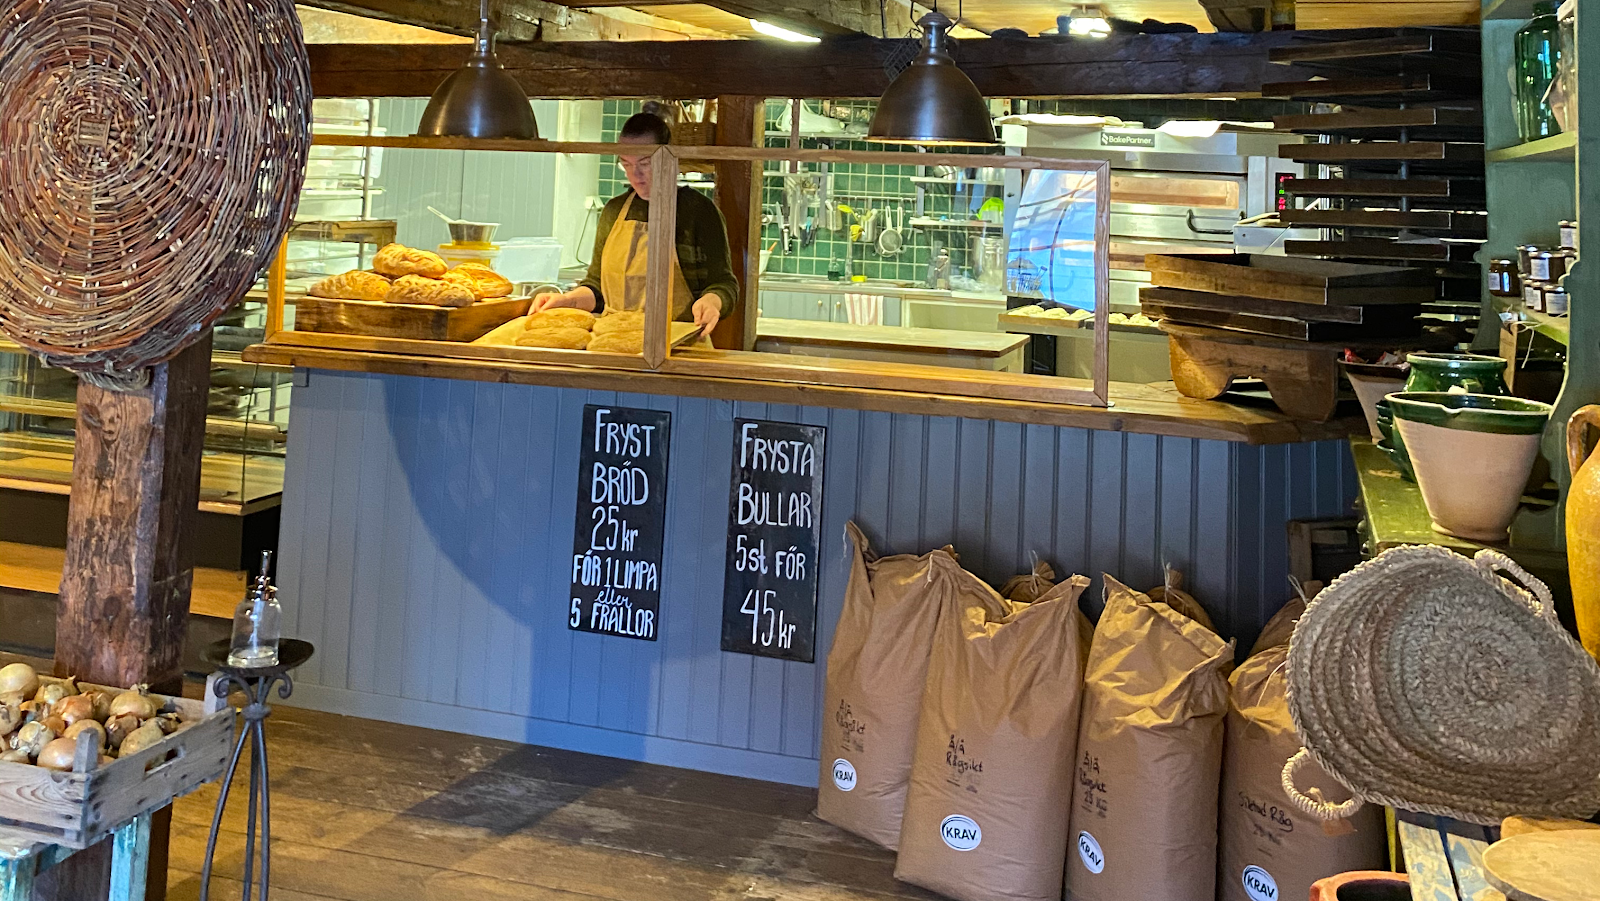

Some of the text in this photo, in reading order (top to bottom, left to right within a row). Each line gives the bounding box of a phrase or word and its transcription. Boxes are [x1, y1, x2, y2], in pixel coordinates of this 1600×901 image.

[1108, 135, 1152, 145] BakePartner
[594, 409, 656, 458] FRYST
[740, 423, 815, 477] FRYSTA
[591, 460, 650, 506] BRÖD
[737, 482, 812, 529] BULLAR
[572, 549, 657, 592] FÖR 1 LIMPA
[775, 545, 806, 581] FÖR
[570, 597, 655, 638] 5 FRALLOR
[834, 770, 854, 782] KRAV
[946, 751, 983, 774] Rågsikt
[945, 827, 977, 841] KRAV
[1080, 838, 1101, 867] KRAV
[1246, 876, 1276, 899] KRAV
